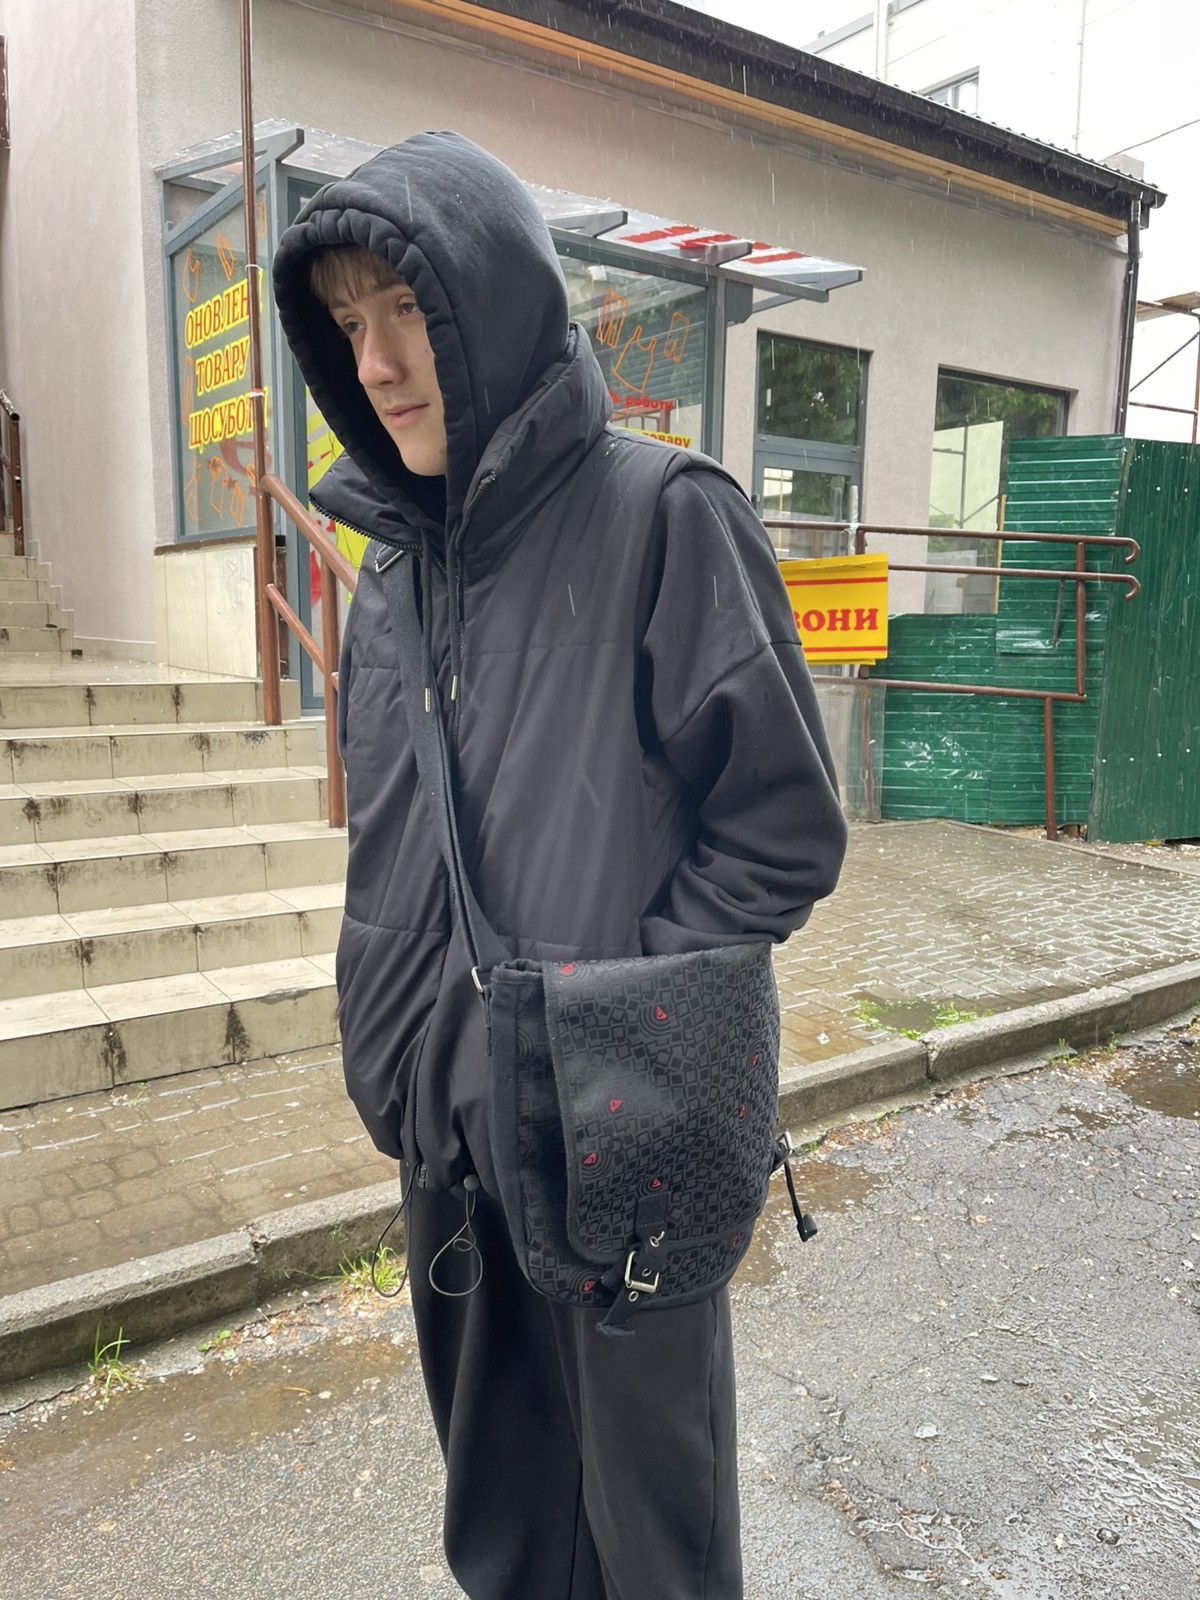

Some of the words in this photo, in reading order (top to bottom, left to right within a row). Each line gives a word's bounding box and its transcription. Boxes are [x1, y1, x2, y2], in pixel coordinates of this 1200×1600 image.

[186, 283, 256, 345] ОНОВЛЕН
[197, 341, 249, 391] ТОВАРУ
[190, 397, 257, 449] ЩОСУБОТ
[642, 431, 691, 449] вару
